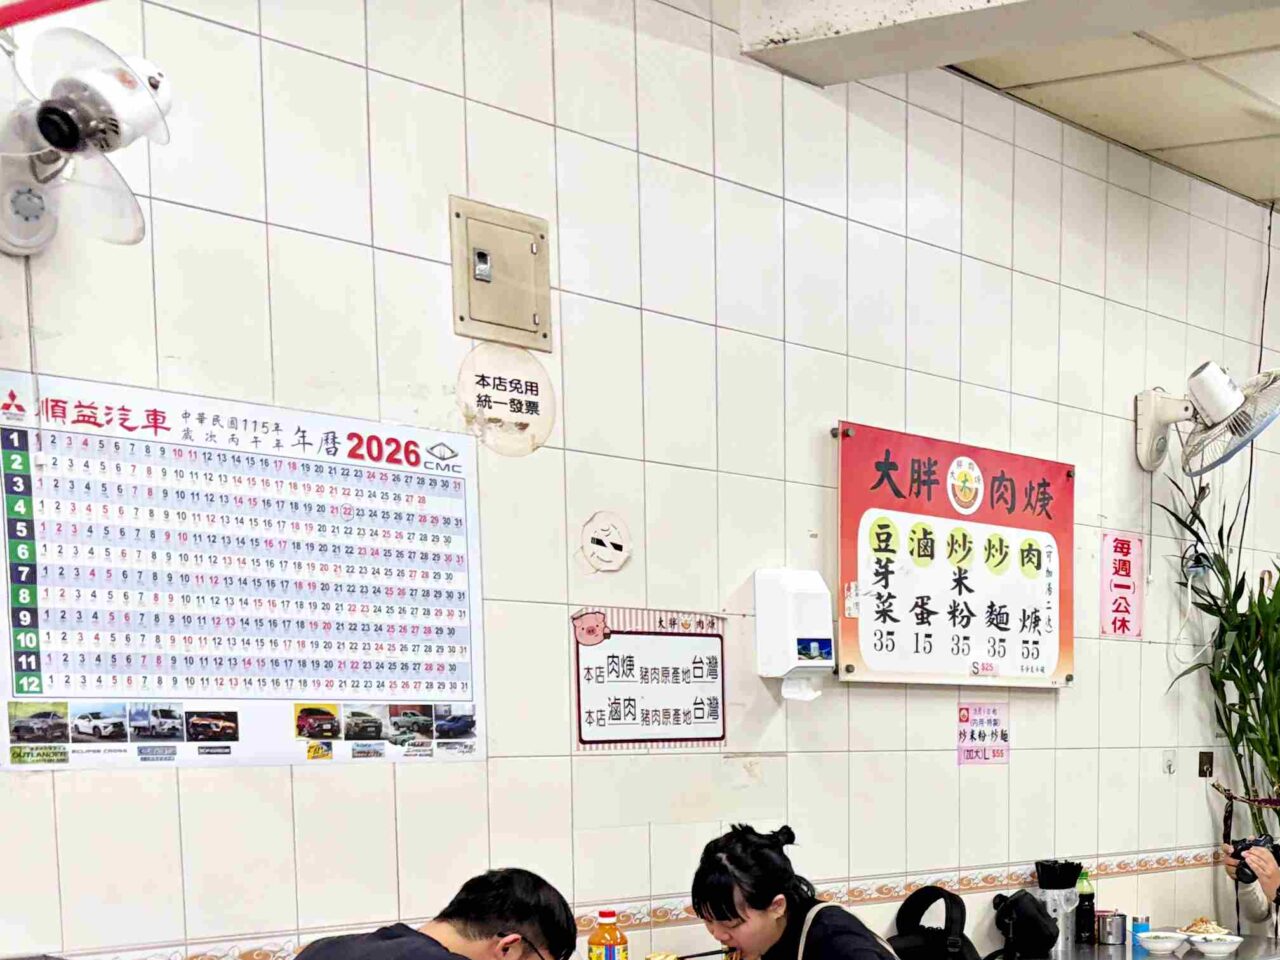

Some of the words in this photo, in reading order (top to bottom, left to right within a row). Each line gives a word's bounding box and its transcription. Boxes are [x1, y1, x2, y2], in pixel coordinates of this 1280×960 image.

[475, 374, 539, 397] 本店免用
[476, 393, 541, 416] 統一發票
[35, 397, 171, 436] 順益汽車
[291, 425, 342, 457] 年曆
[346, 432, 421, 467] 2026
[423, 460, 463, 473] CMC
[9, 432, 20, 447] 1
[50, 434, 56, 444] 2
[66, 436, 72, 445] 3
[81, 437, 88, 447] 4
[98, 439, 104, 449] 5
[114, 441, 120, 450] 6
[129, 442, 135, 452] 7
[144, 444, 150, 453] 8
[159, 445, 165, 455] 9
[172, 448, 182, 457] 10
[187, 449, 197, 459] 11
[202, 451, 212, 461] 12
[216, 452, 227, 462] 13
[231, 454, 241, 464] 14
[245, 456, 255, 465] 15
[259, 457, 269, 467] 16
[273, 459, 282, 469] 17
[287, 460, 297, 470] 18
[300, 462, 310, 472] 19
[314, 463, 323, 473] 20
[327, 465, 336, 474] 21
[340, 467, 349, 476] 22
[353, 469, 363, 477] 23
[366, 470, 375, 479] 24
[379, 472, 388, 480] 25
[391, 473, 400, 482] 26
[404, 475, 413, 484] 27
[416, 476, 425, 485] 28
[428, 478, 437, 487] 29
[440, 479, 449, 488] 30
[452, 481, 460, 490] 31
[10, 454, 23, 470] 2
[869, 448, 940, 502] 大胖
[989, 469, 1054, 520] 肉焿
[12, 477, 25, 492] 3
[37, 477, 43, 486] 1
[53, 478, 59, 487] 2
[68, 479, 74, 489] 3
[84, 481, 90, 490] 4
[101, 482, 107, 492] 5
[116, 484, 123, 493] 6
[131, 485, 137, 494] 7
[147, 486, 153, 496] 8
[162, 488, 168, 497] 9
[175, 490, 185, 500] 10
[190, 491, 199, 501] 11
[203, 493, 214, 502] 12
[219, 494, 229, 504] 13
[233, 495, 243, 505] 14
[247, 497, 257, 506] 15
[261, 498, 271, 508] 16
[275, 499, 285, 509] 17
[289, 500, 299, 510] 18
[303, 502, 312, 511] 19
[316, 503, 325, 513] 20
[329, 505, 338, 513] 21
[342, 506, 351, 514] 22
[355, 507, 365, 516] 23
[368, 508, 377, 517] 24
[380, 509, 390, 518] 25
[393, 511, 402, 519] 26
[405, 512, 414, 520] 27
[418, 513, 427, 521] 28
[430, 514, 439, 523] 29
[442, 515, 450, 524] 30
[454, 516, 462, 525] 31
[14, 499, 27, 515] 4
[16, 522, 28, 537] 5
[16, 543, 30, 560] 6
[18, 566, 30, 581] 7
[872, 524, 900, 624] 豆芽菜
[909, 527, 939, 627] 滷蛋
[947, 533, 977, 629] 炒米粉
[984, 537, 1011, 632] 炒麵
[18, 587, 31, 603] 8
[1019, 543, 1042, 636] 肉焿
[1110, 538, 1135, 634] 每週(一)公休
[19, 610, 32, 626] 9
[16, 632, 37, 649] 10
[873, 629, 895, 652] 35
[914, 632, 933, 655] 15
[951, 634, 971, 656] 35
[987, 636, 1007, 658] 35
[1021, 640, 1040, 660] 55
[18, 654, 37, 671] 11
[46, 653, 52, 662] 1
[62, 653, 69, 662] 2
[79, 653, 85, 662] 3
[95, 654, 101, 663] 4
[111, 654, 117, 663] 5
[125, 654, 131, 663] 6
[140, 654, 147, 664] 7
[155, 655, 161, 664] 8
[170, 655, 176, 664] 9
[183, 656, 194, 665] 10
[198, 657, 208, 666] 11
[213, 657, 223, 666] 12
[227, 657, 237, 666] 13
[241, 658, 252, 667] 14
[255, 658, 265, 667] 15
[269, 658, 279, 667] 16
[283, 659, 293, 668] 17
[972, 661, 980, 675] S
[981, 662, 994, 672] $25
[19, 676, 41, 692] 12
